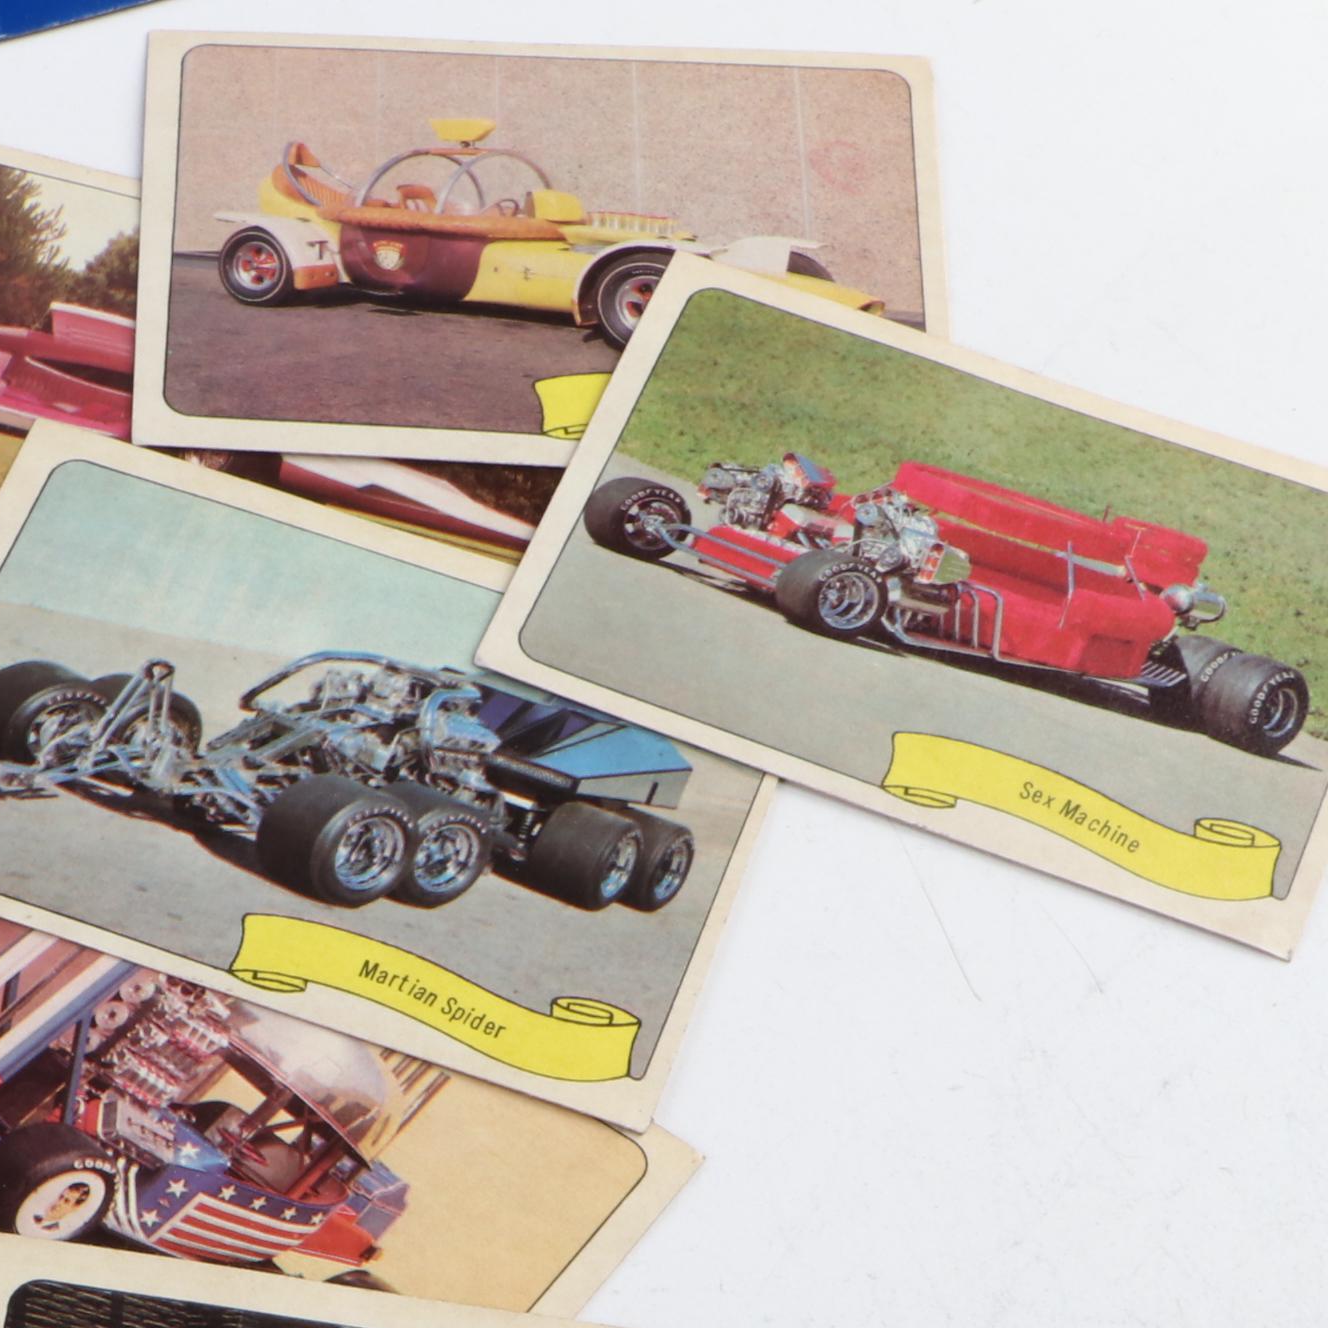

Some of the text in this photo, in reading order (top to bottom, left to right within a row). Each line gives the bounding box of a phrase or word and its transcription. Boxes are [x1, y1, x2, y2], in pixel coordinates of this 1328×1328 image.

[1019, 780, 1141, 855] Sex Machine
[357, 958, 508, 1040] Martian Spider
